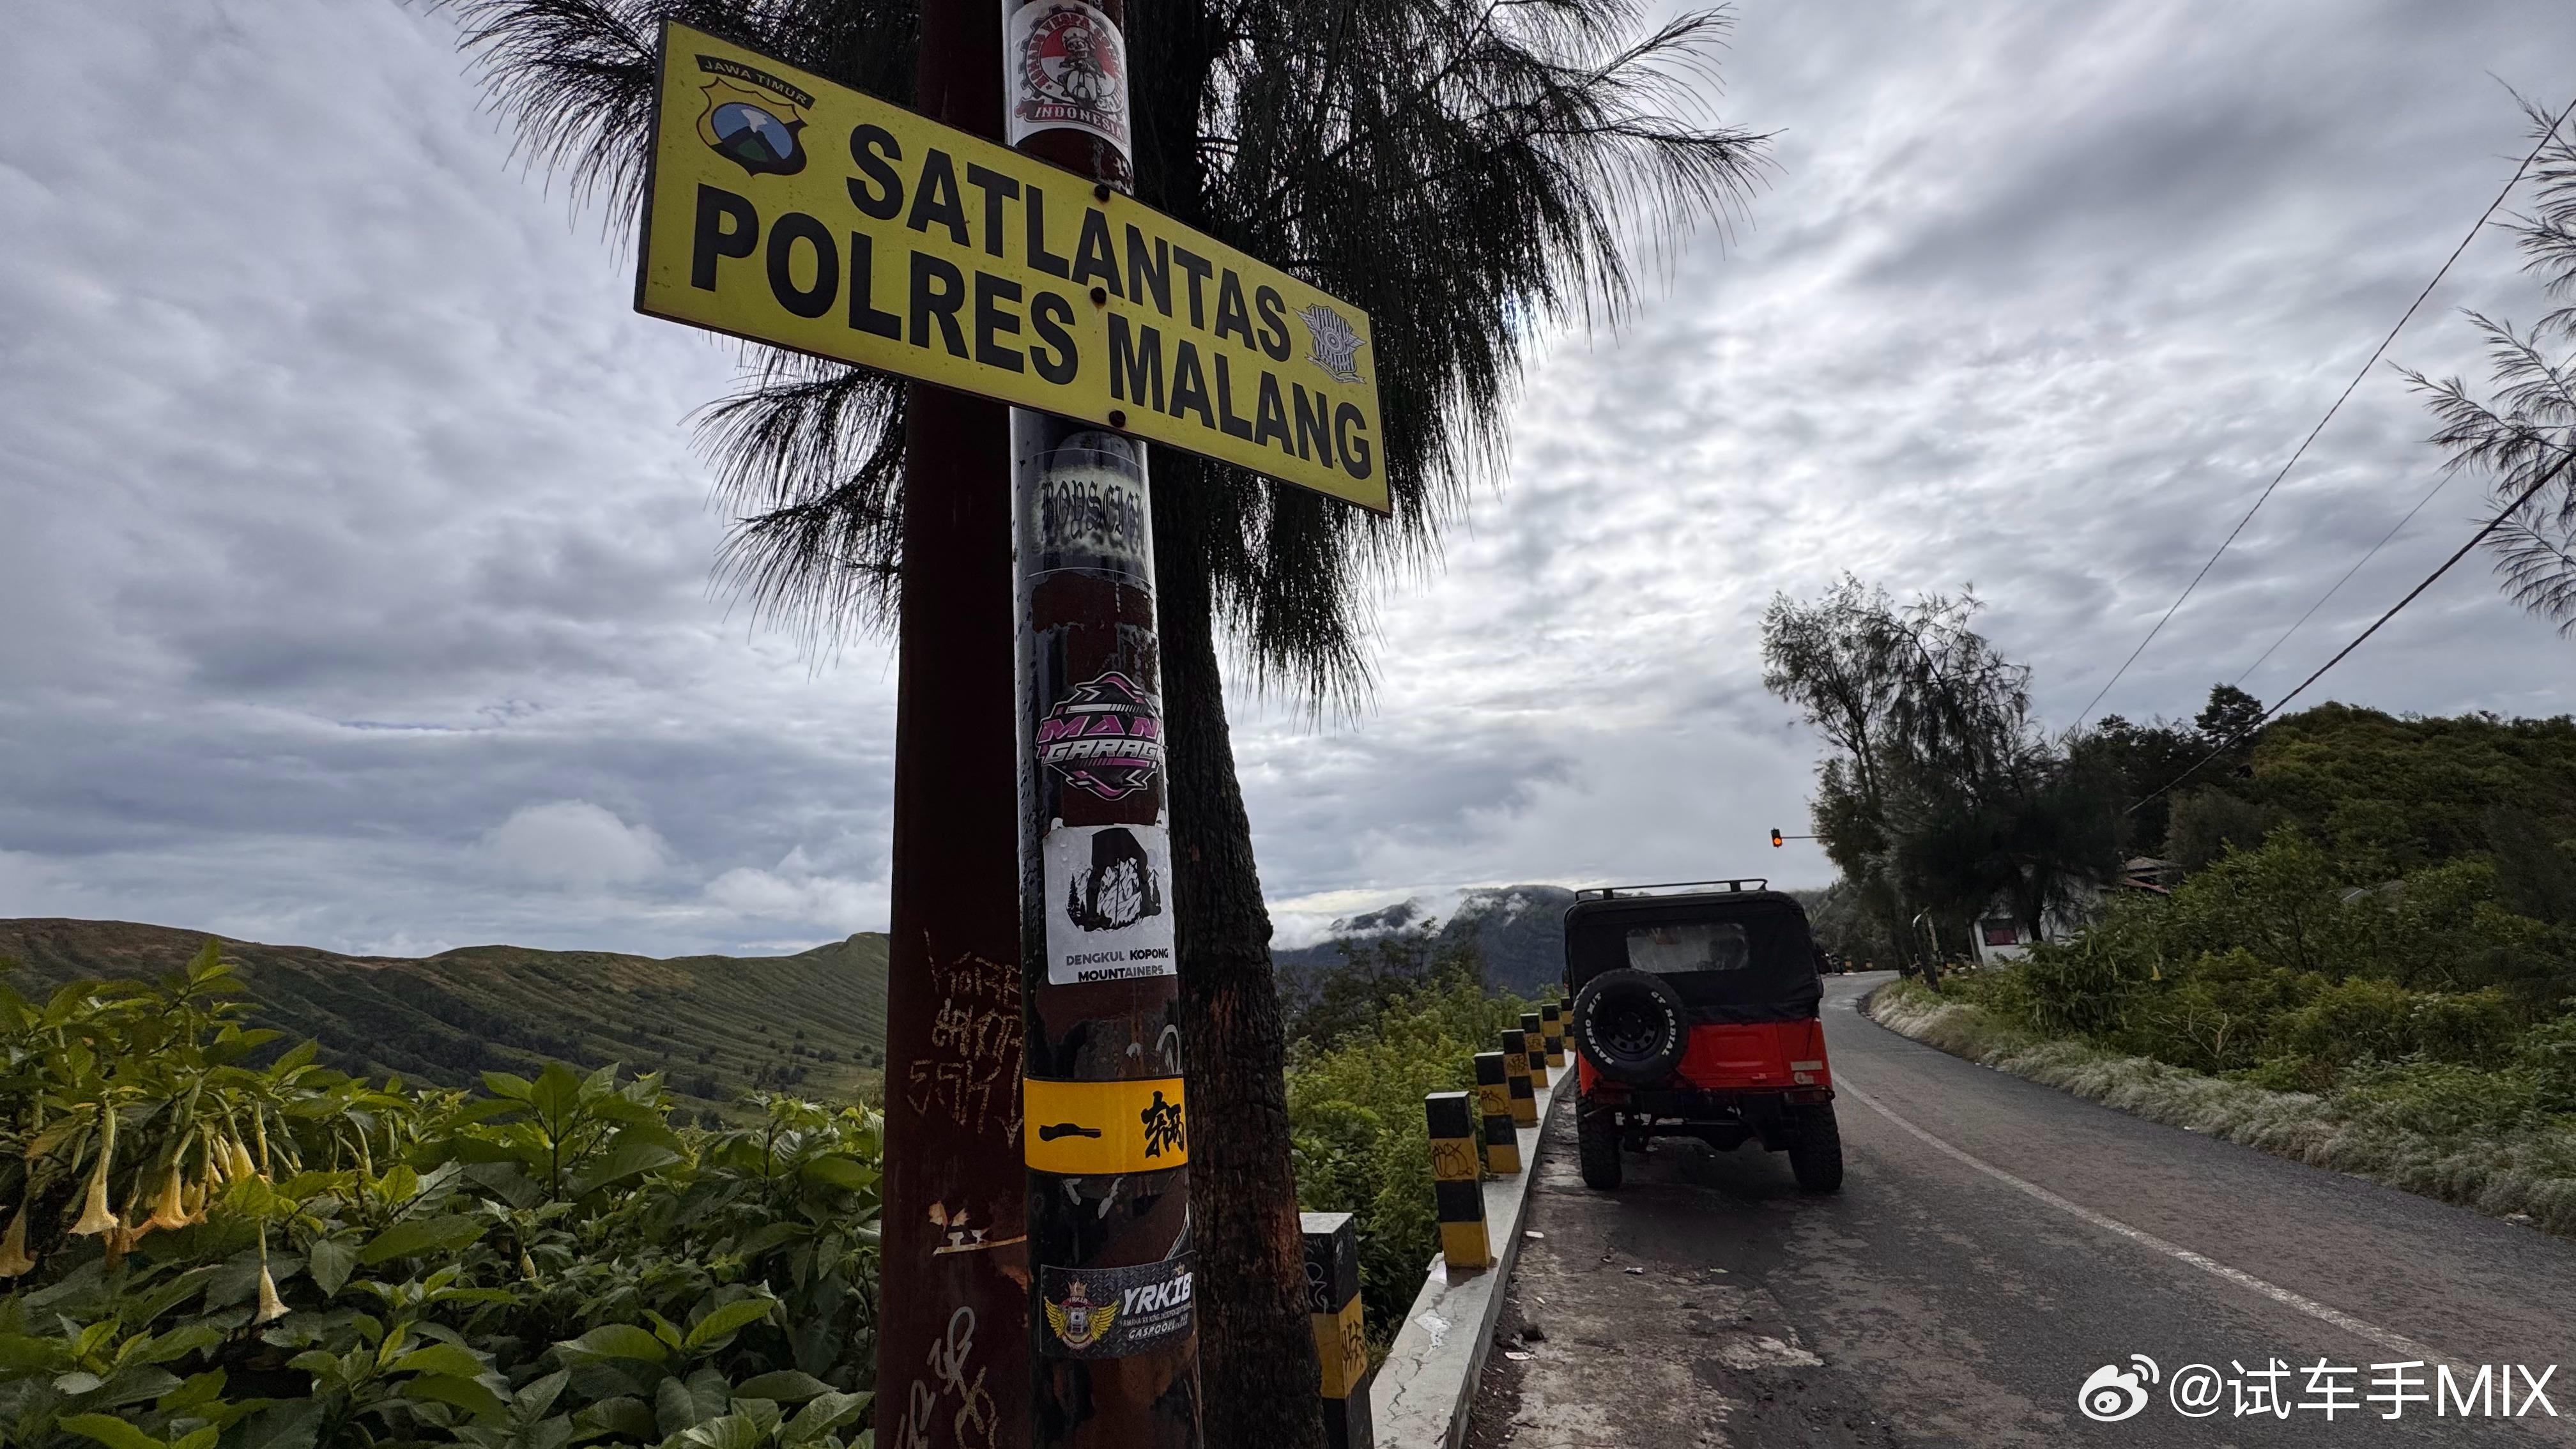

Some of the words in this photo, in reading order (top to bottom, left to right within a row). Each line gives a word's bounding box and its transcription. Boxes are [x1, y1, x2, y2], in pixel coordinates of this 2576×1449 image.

[705, 60, 751, 79] JAWA
[756, 74, 807, 104] TIMUR
[1035, 106, 1123, 140] INDONESIA
[847, 125, 1291, 362] SATLANTAS
[692, 183, 1078, 385] POLRES
[1108, 312, 1371, 480] MALANG
[1066, 951, 1125, 966] DENGKUL
[1130, 948, 1169, 960] KOPONG
[1078, 965, 1164, 983] MOUNTAINERS
[1661, 1008, 1677, 1056] RADIAL
[1122, 1272, 1193, 1316] YRKIB
